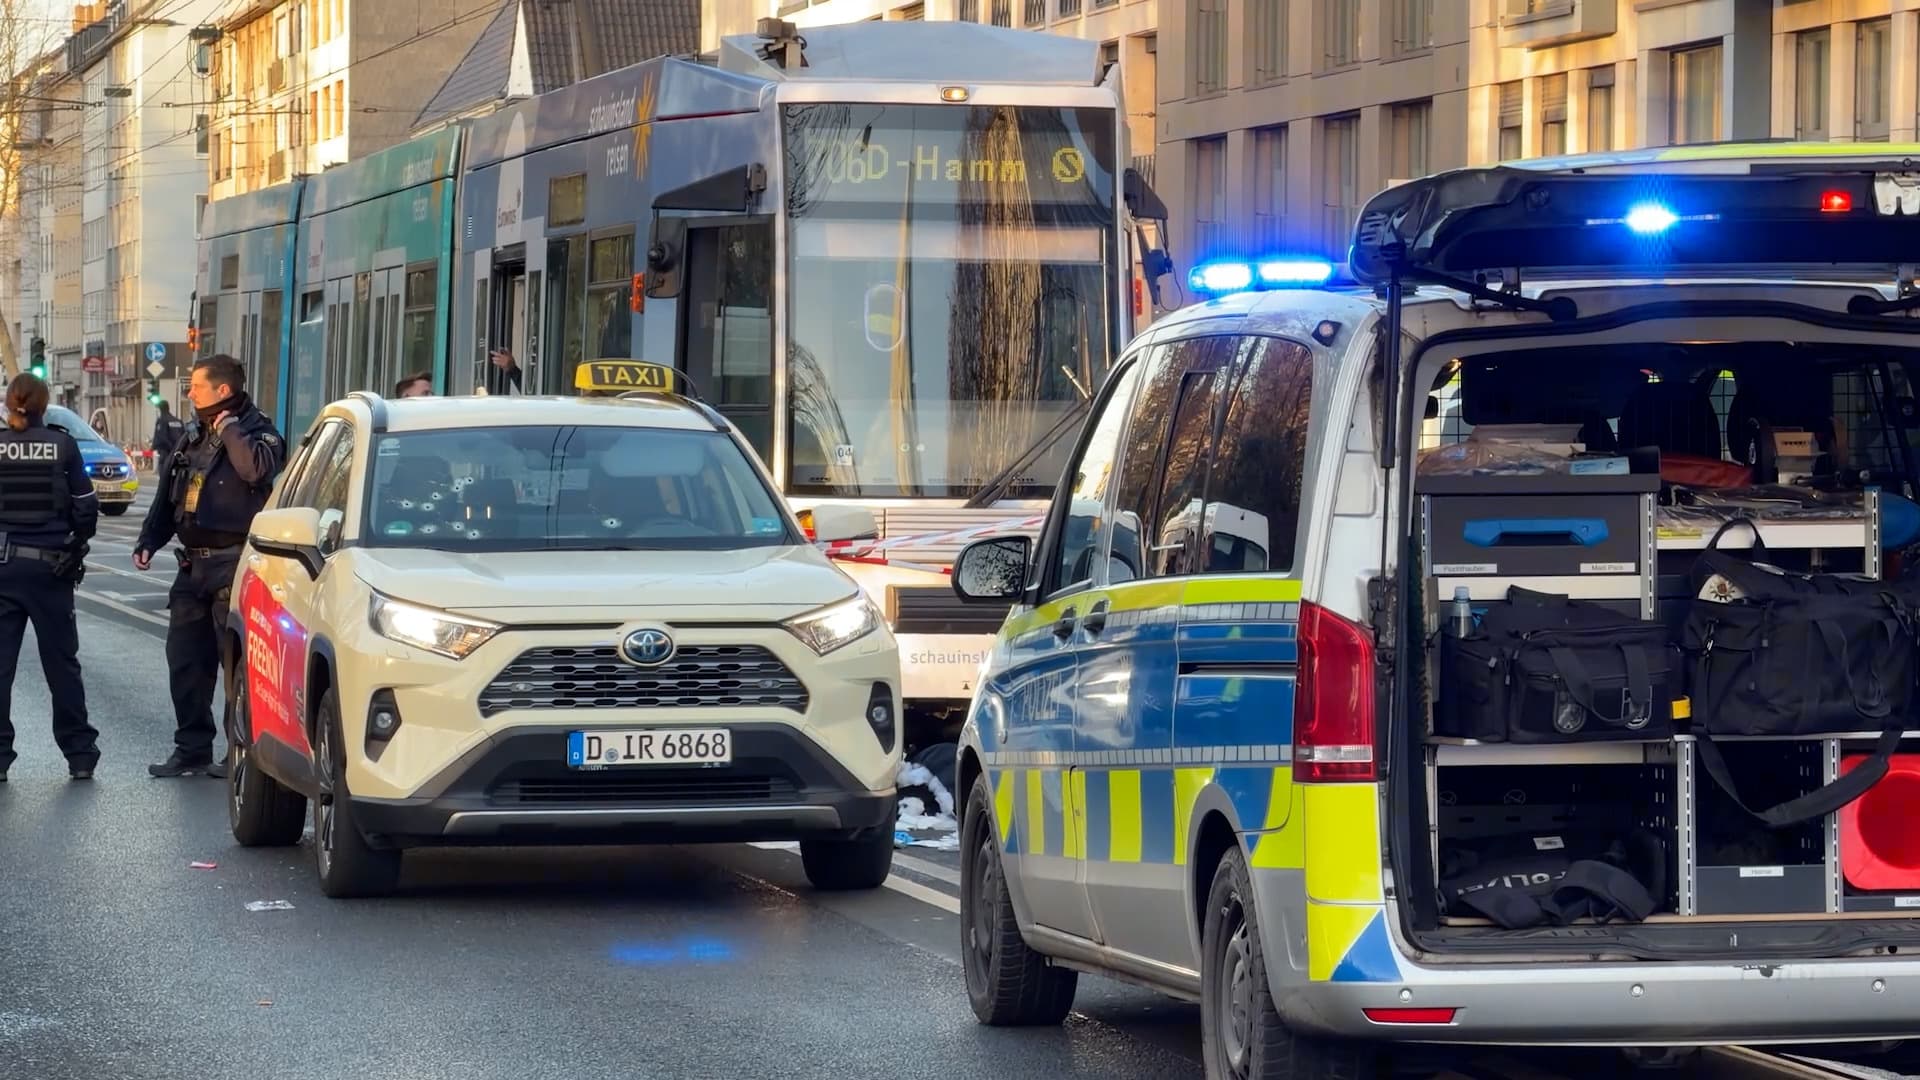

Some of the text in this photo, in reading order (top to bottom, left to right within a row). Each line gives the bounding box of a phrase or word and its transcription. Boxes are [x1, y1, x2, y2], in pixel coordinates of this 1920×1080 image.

[606, 136, 629, 177] reisen
[597, 365, 660, 387] TAXI
[0, 442, 58, 461] POLIZEI
[586, 735, 602, 761] D
[622, 734, 655, 760] IR
[661, 733, 727, 759] 6868
